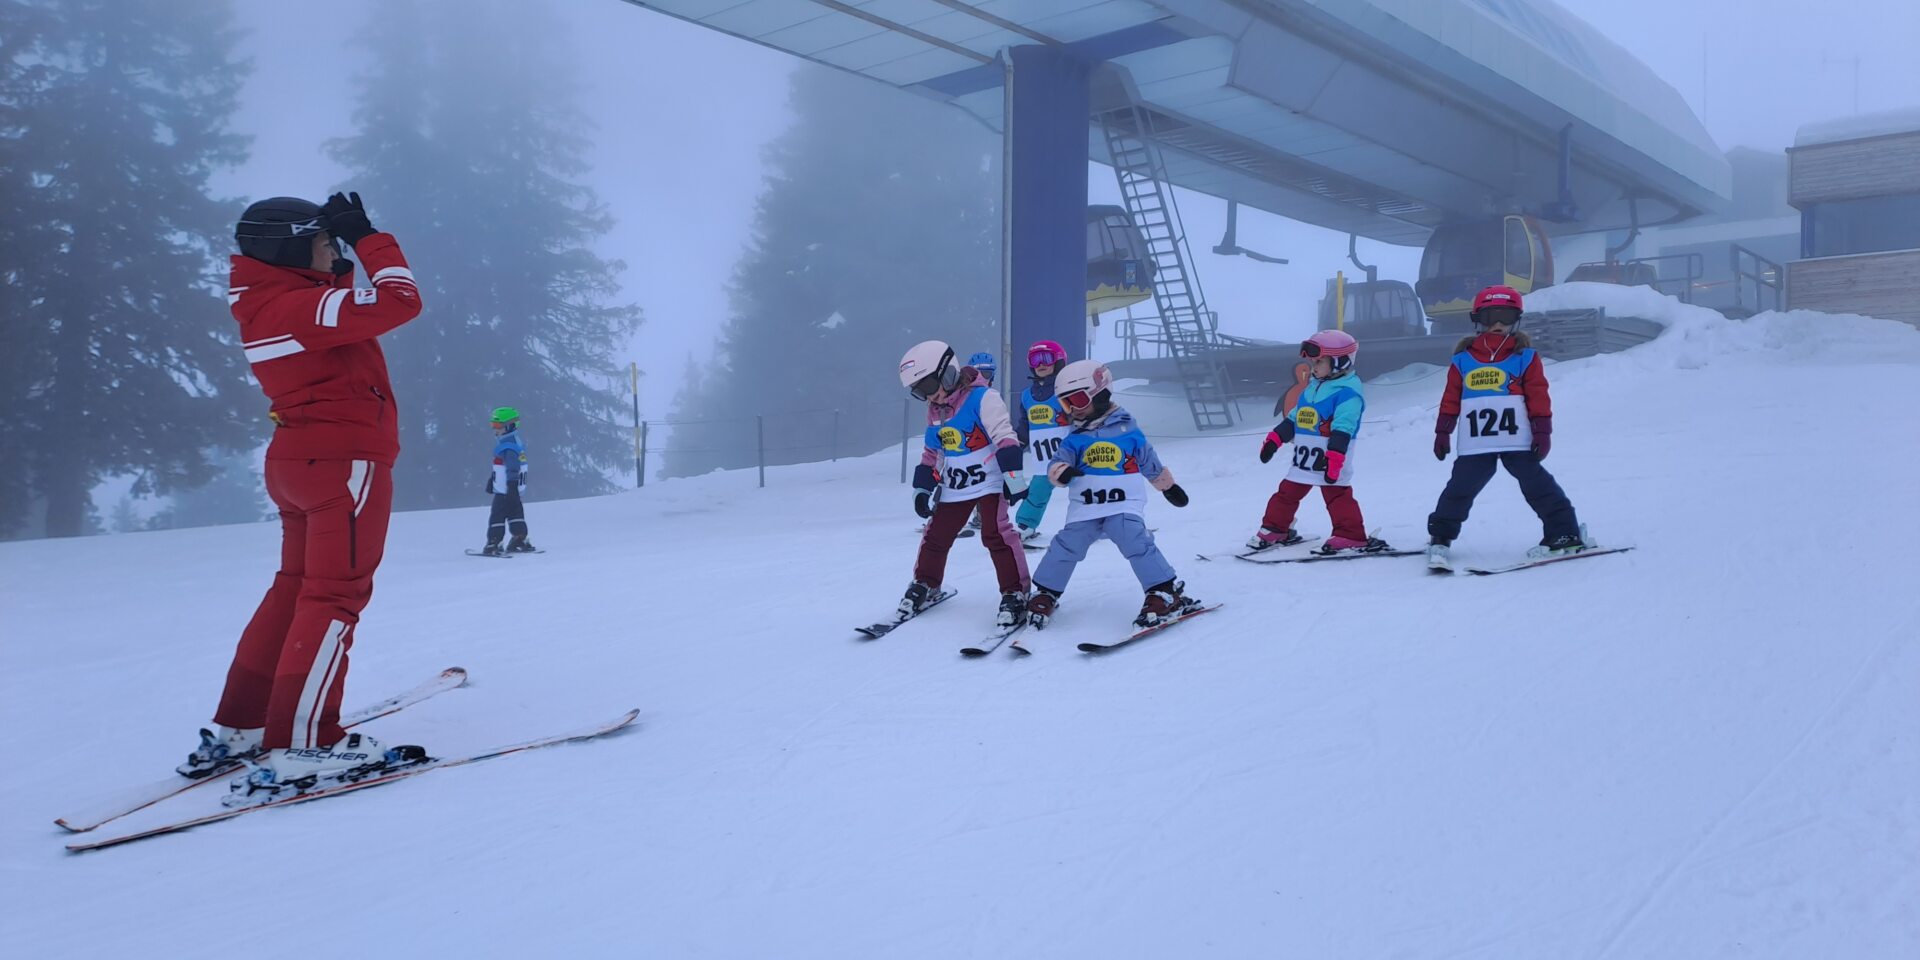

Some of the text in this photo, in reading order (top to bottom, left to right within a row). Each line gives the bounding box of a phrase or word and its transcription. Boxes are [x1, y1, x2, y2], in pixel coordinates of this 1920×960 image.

[1471, 370, 1500, 379] GRÜSCH
[1466, 407, 1519, 437] 124
[1293, 445, 1327, 471] 122
[947, 464, 986, 490] 125
[284, 748, 369, 761] FISCHER
